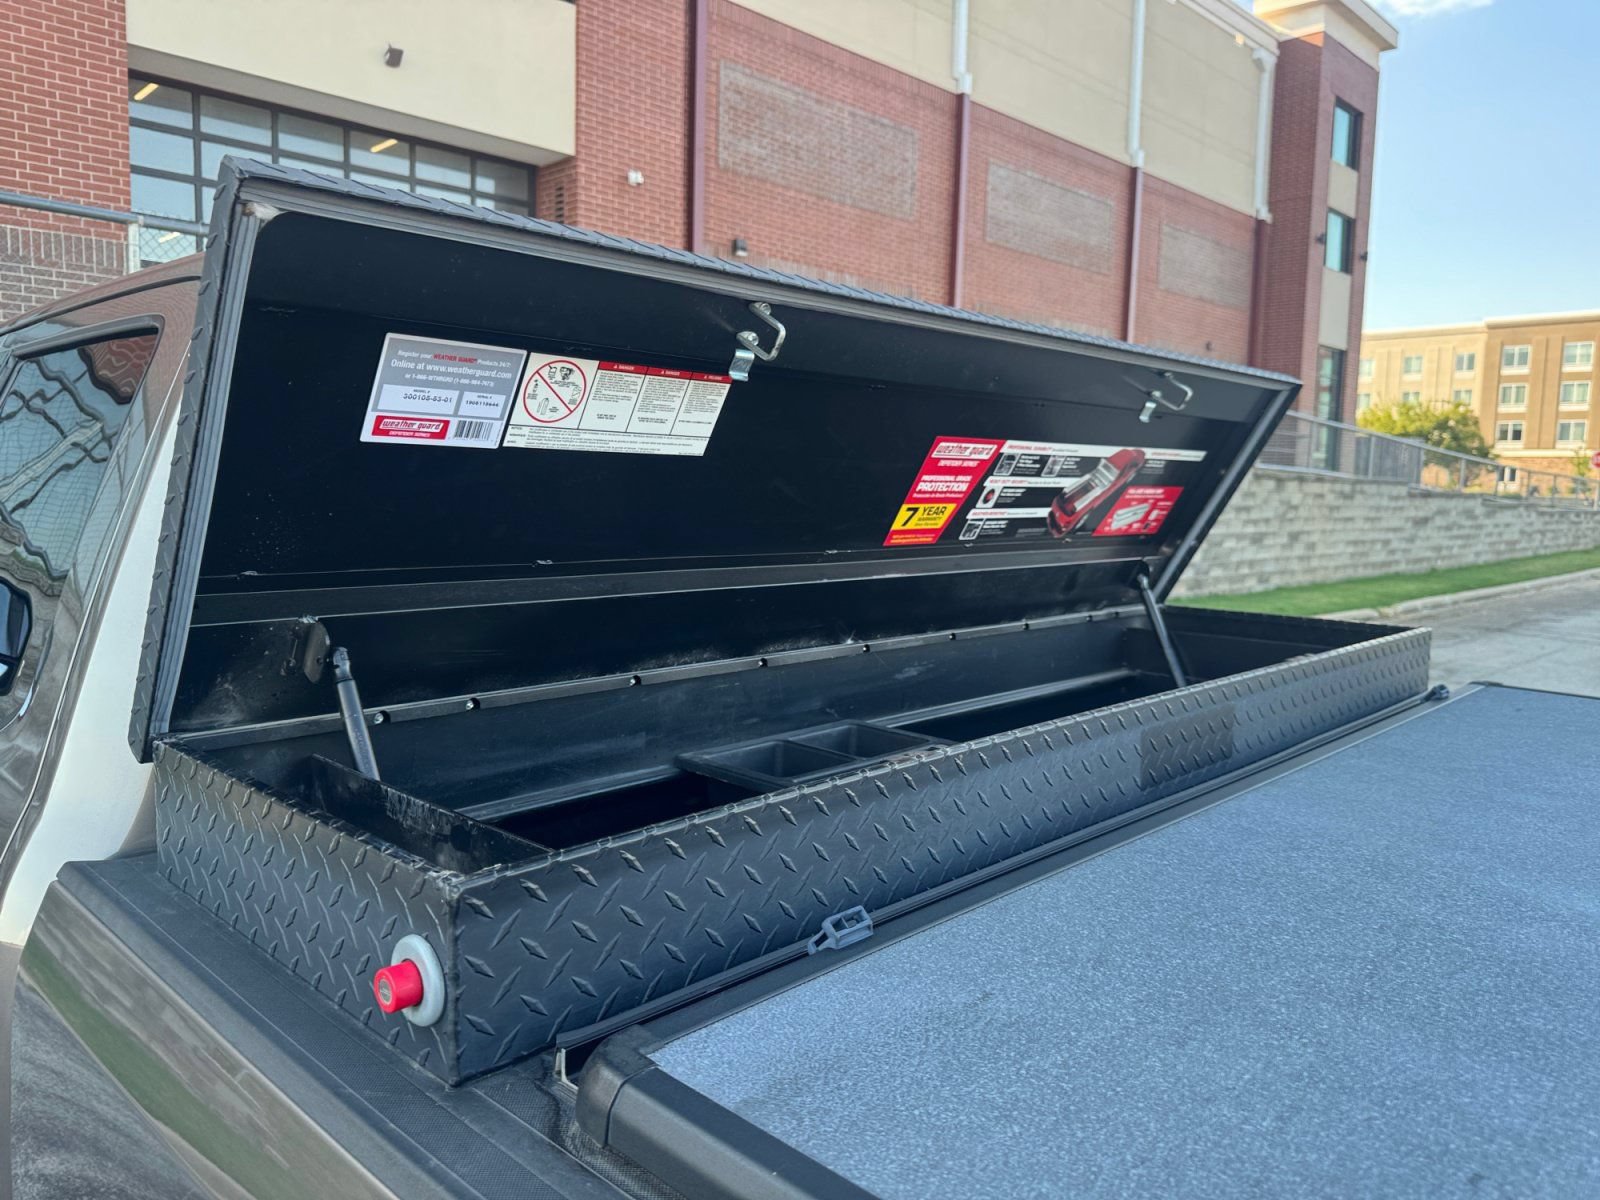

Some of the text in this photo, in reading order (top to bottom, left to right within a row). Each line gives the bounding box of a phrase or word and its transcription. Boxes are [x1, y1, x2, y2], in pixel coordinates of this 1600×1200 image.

[432, 353, 457, 362] WEATHER
[391, 359, 512, 379] Online at www.weatherguard.com
[382, 420, 441, 431] weather guard
[936, 444, 993, 456] weather guard
[916, 482, 970, 492] PROTECTION
[922, 506, 947, 516] YEAR
[902, 507, 920, 527] 7
